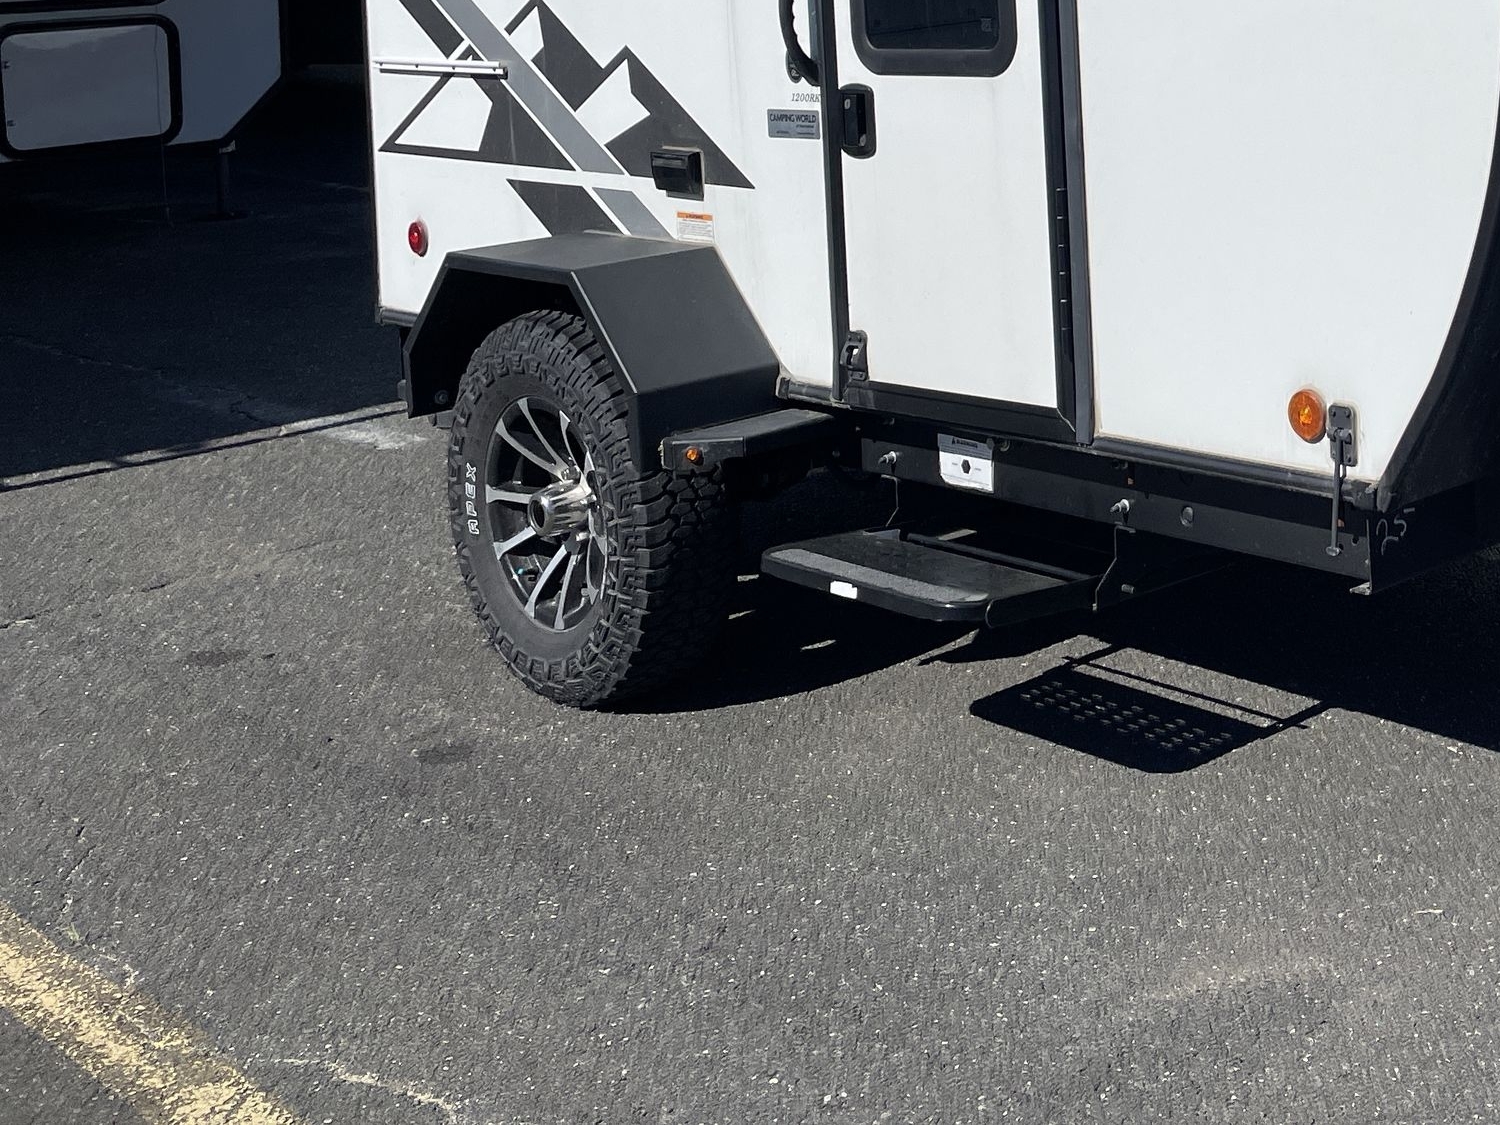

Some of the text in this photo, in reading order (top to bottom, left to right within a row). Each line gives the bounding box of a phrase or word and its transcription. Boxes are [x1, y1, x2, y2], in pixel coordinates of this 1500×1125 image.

[769, 113, 817, 124] CAMPING WORLD
[465, 462, 480, 535] APEX
